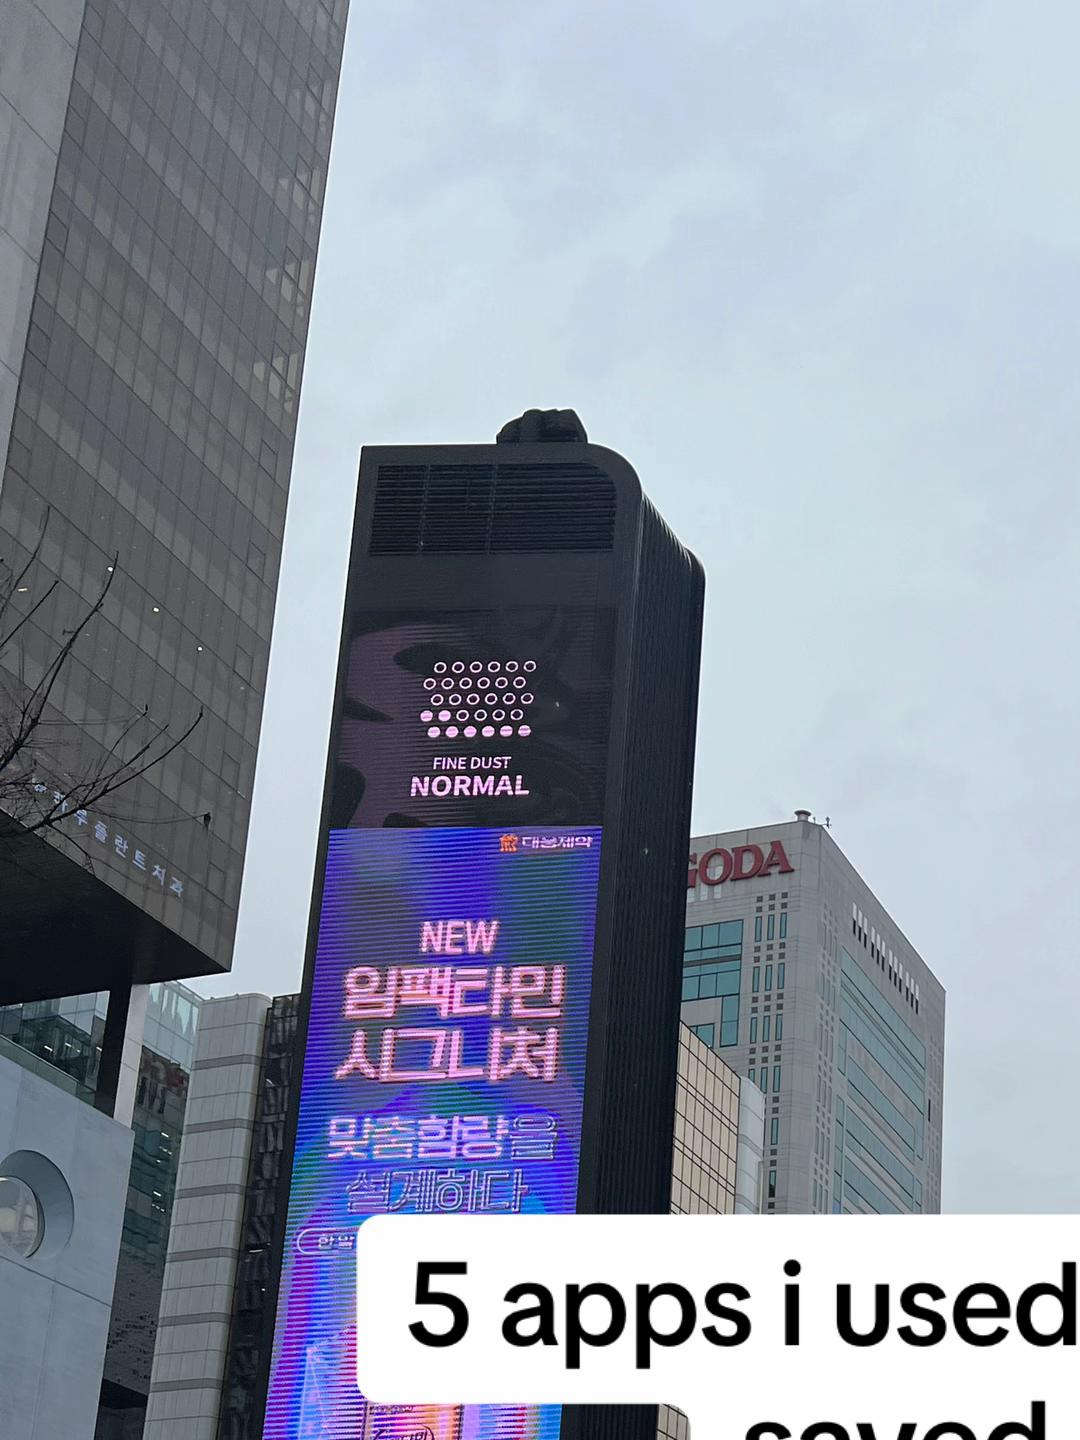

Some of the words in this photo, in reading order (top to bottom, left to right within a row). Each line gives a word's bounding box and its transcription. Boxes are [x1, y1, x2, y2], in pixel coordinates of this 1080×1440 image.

[432, 757, 468, 770] FINE
[470, 756, 512, 769] DUST
[410, 775, 530, 797] NORMAL
[521, 836, 593, 848] 대웅제약
[418, 920, 499, 954] NEW
[341, 964, 566, 1020] 임팩타민
[334, 1026, 561, 1082] 시그니처
[326, 1113, 559, 1162] 맞춤함량을
[345, 1168, 529, 1213] 설계하다
